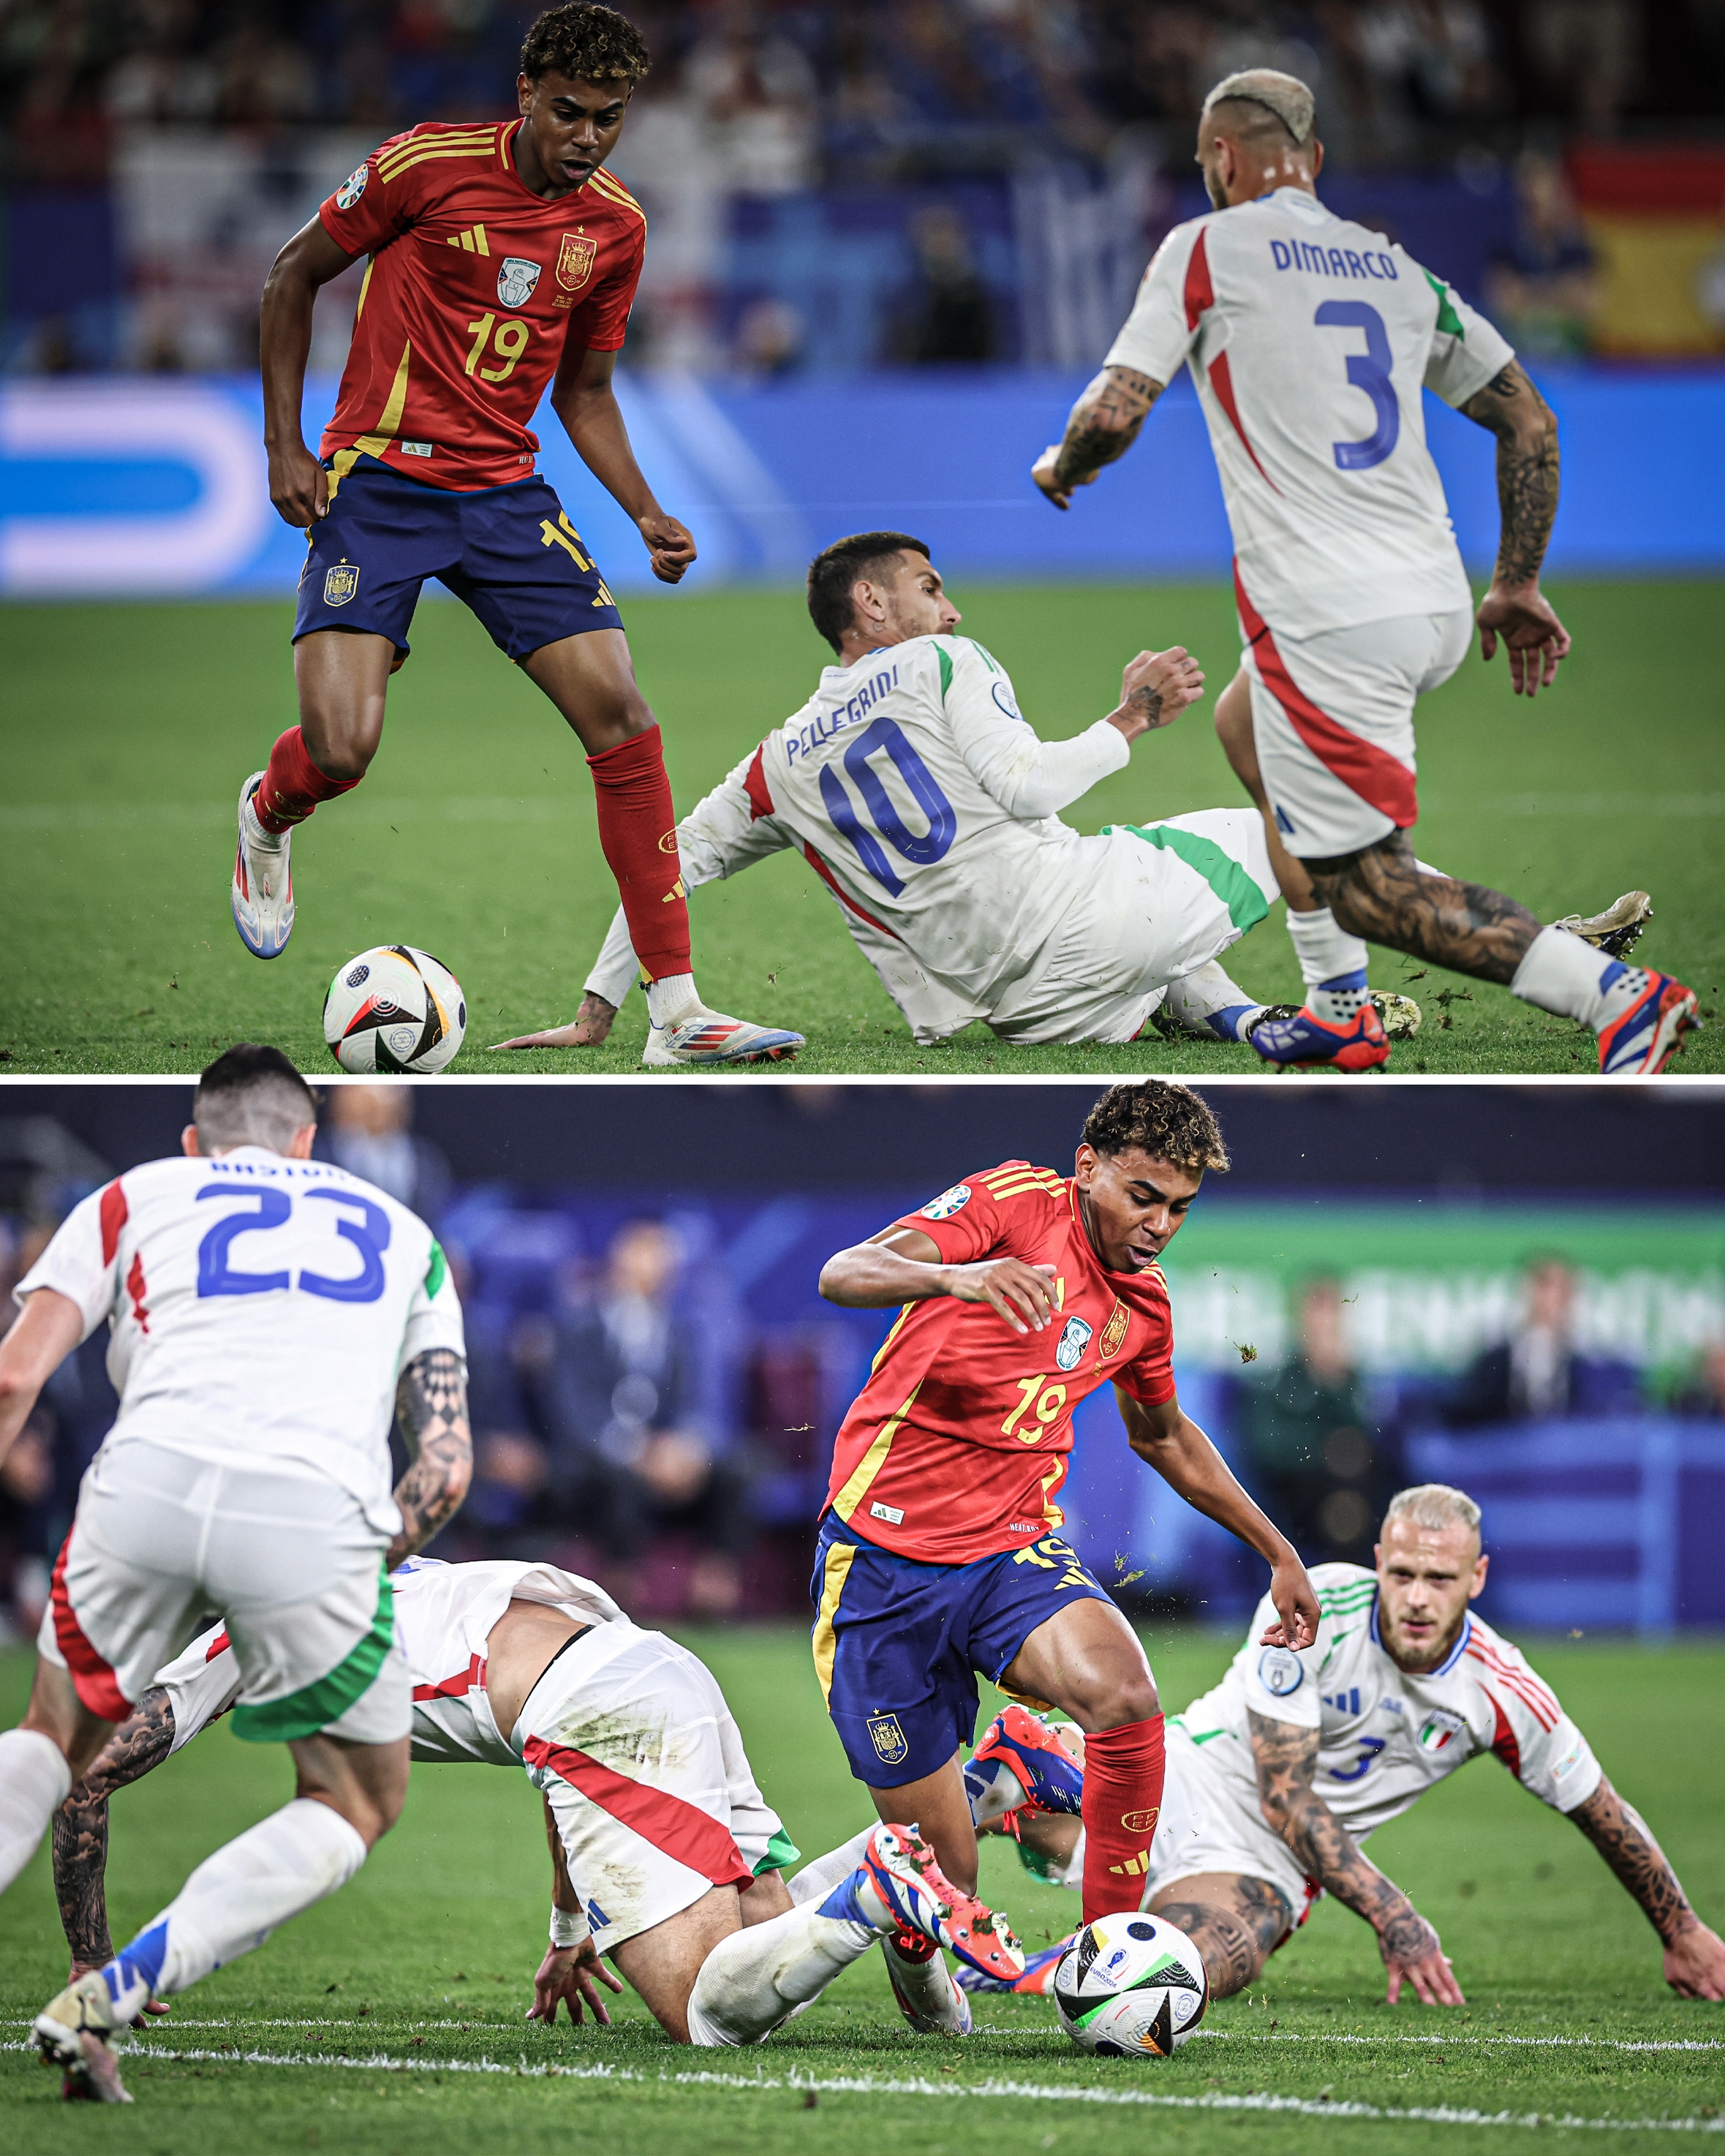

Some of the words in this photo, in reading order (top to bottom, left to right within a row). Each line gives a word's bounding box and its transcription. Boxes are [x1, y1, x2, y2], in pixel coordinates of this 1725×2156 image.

[1269, 238, 1398, 281] DIMARCO
[465, 312, 529, 382] 19
[1313, 299, 1400, 470] 3
[786, 664, 898, 767] PELLEGRINI
[820, 717, 957, 899] 10
[196, 1182, 392, 1303] 23
[1000, 1373, 1067, 1444] 19
[1012, 1537, 1082, 1568] 19
[1328, 1735, 1386, 1782] 3
